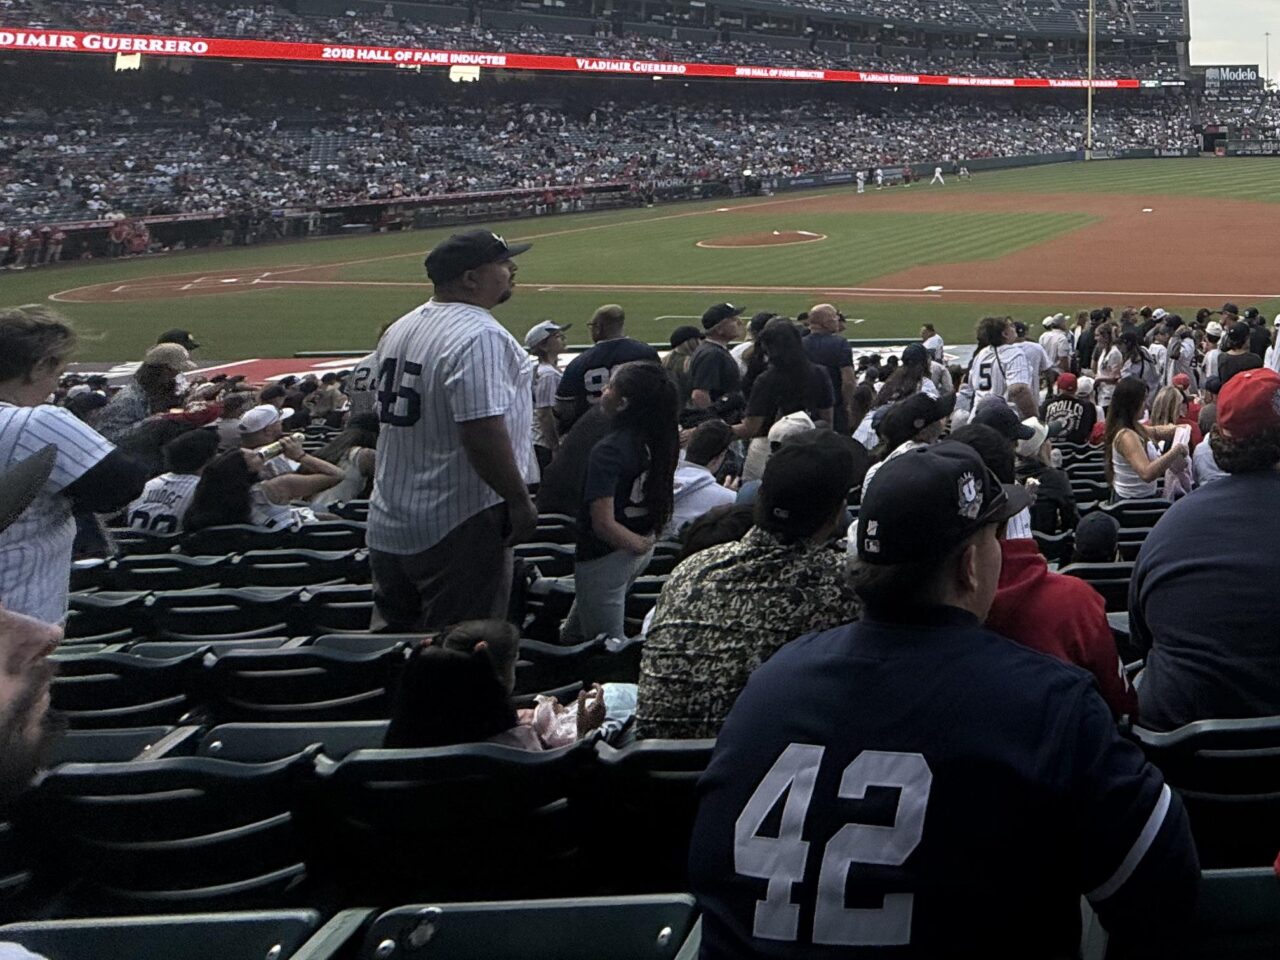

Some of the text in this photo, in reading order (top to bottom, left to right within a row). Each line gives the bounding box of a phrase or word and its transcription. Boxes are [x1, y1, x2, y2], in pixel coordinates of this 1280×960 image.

[82, 34, 208, 53] GUERRERO
[322, 47, 507, 65] 2018 HALL OF FAME INDUCTEE
[576, 58, 687, 74] VLADIMIR GUERRERO
[1220, 68, 1256, 81] Modelo
[979, 363, 992, 391] 5
[378, 357, 423, 428] 45
[734, 742, 934, 947] 42
